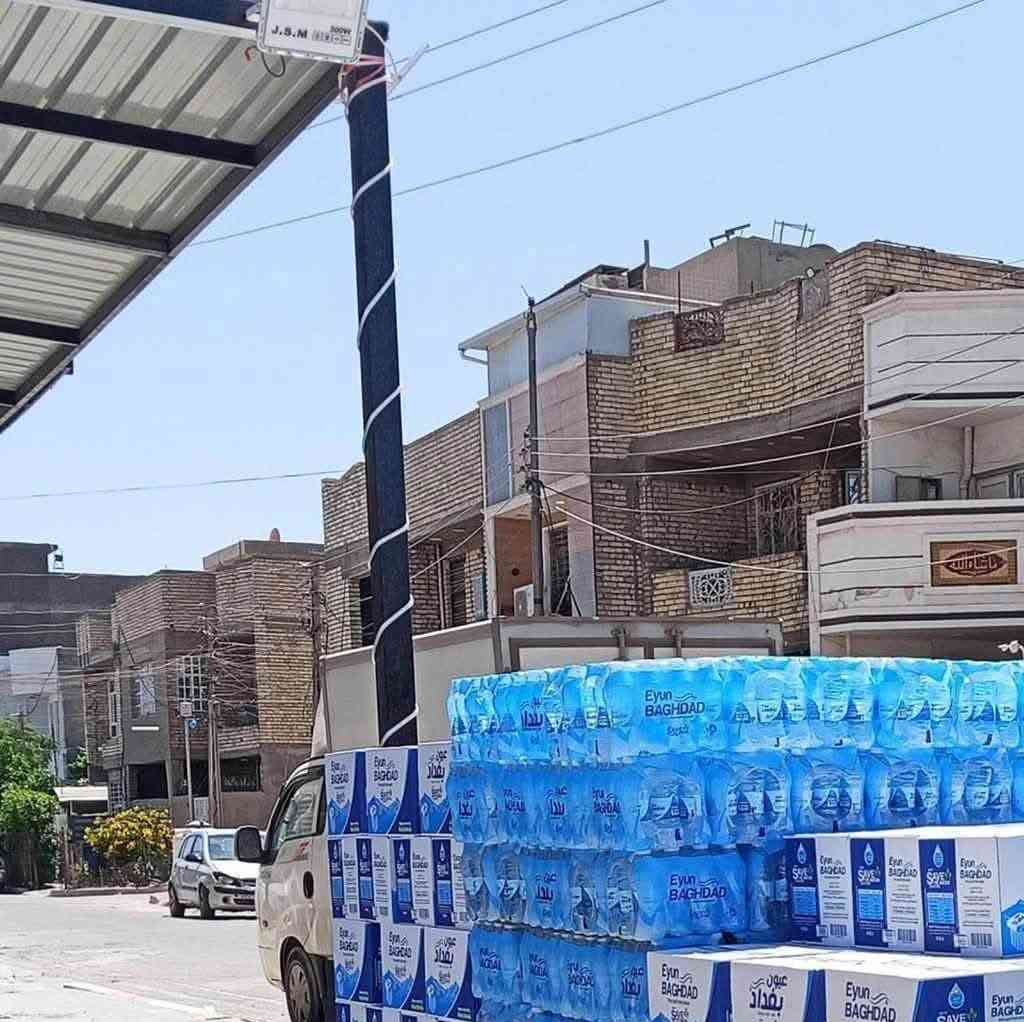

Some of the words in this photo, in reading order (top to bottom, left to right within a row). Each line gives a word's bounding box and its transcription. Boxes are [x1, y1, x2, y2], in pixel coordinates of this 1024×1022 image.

[272, 24, 307, 38] J.S.M
[645, 689, 672, 703] Eyun
[645, 702, 705, 716] BAGHDAD
[820, 866, 846, 875] BAGHDAD
[888, 868, 918, 878] BAGHDAD
[960, 869, 992, 879] BAGHDAD
[670, 874, 696, 888] Eyun
[669, 886, 727, 900] BAGHDAD
[661, 963, 679, 979] Eyun
[766, 974, 788, 988] عيون
[661, 981, 698, 1000] BAGHDAD
[846, 982, 870, 1000] Eyun
[749, 988, 783, 1017] بغداد
[992, 995, 1014, 1007] Eyun
